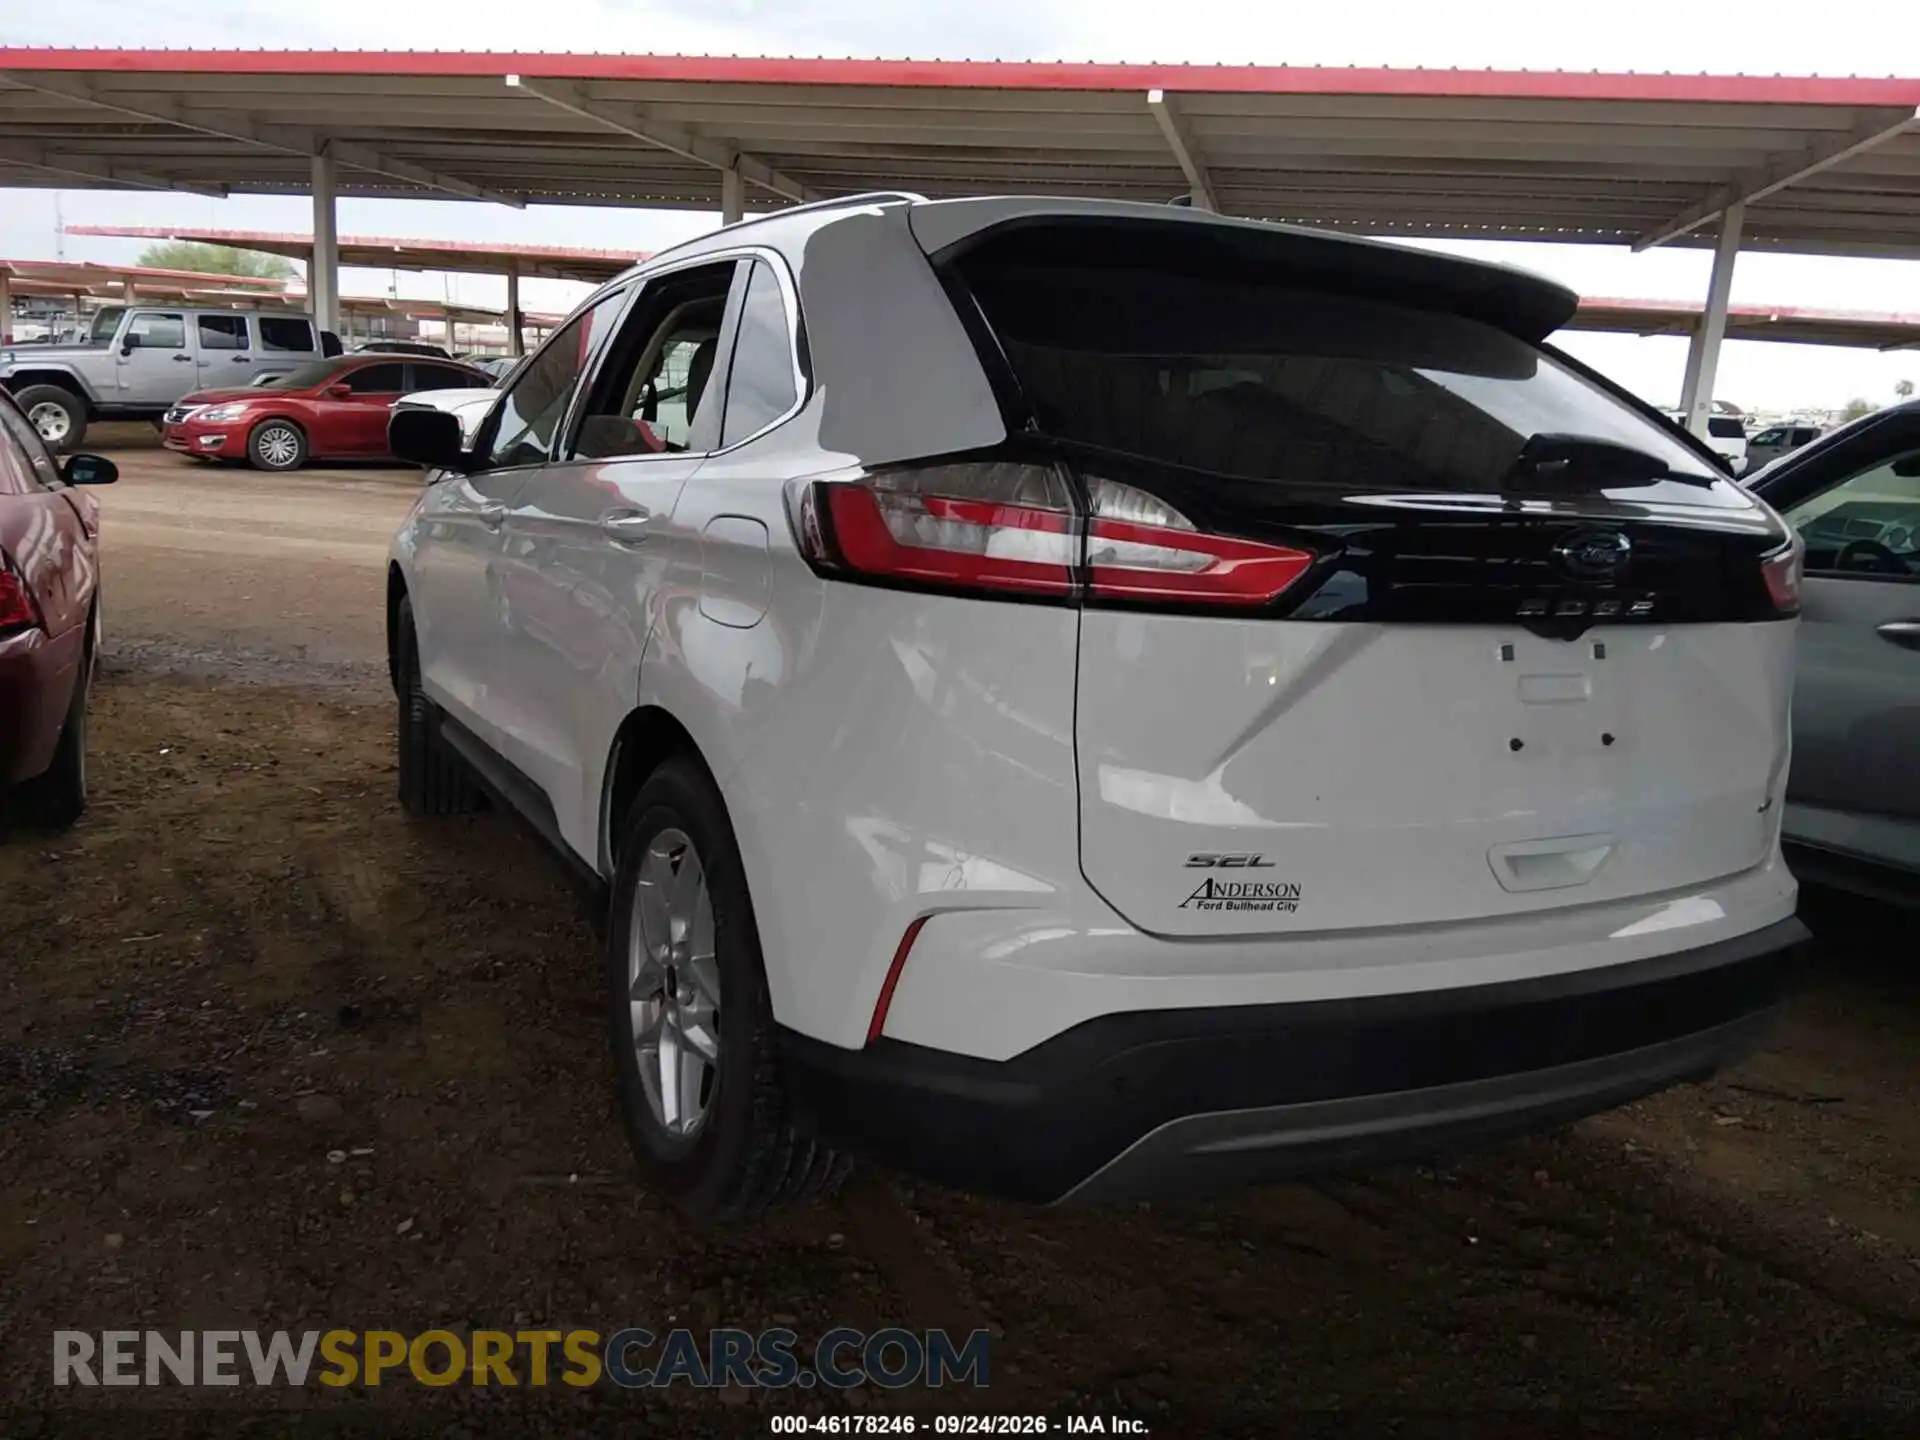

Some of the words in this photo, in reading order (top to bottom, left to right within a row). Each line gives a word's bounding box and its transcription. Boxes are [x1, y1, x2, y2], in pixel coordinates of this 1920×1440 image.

[1183, 853, 1277, 868] SEL
[1197, 900, 1223, 911] Ford
[1226, 900, 1274, 911] Bullhead
[1277, 901, 1298, 913] City
